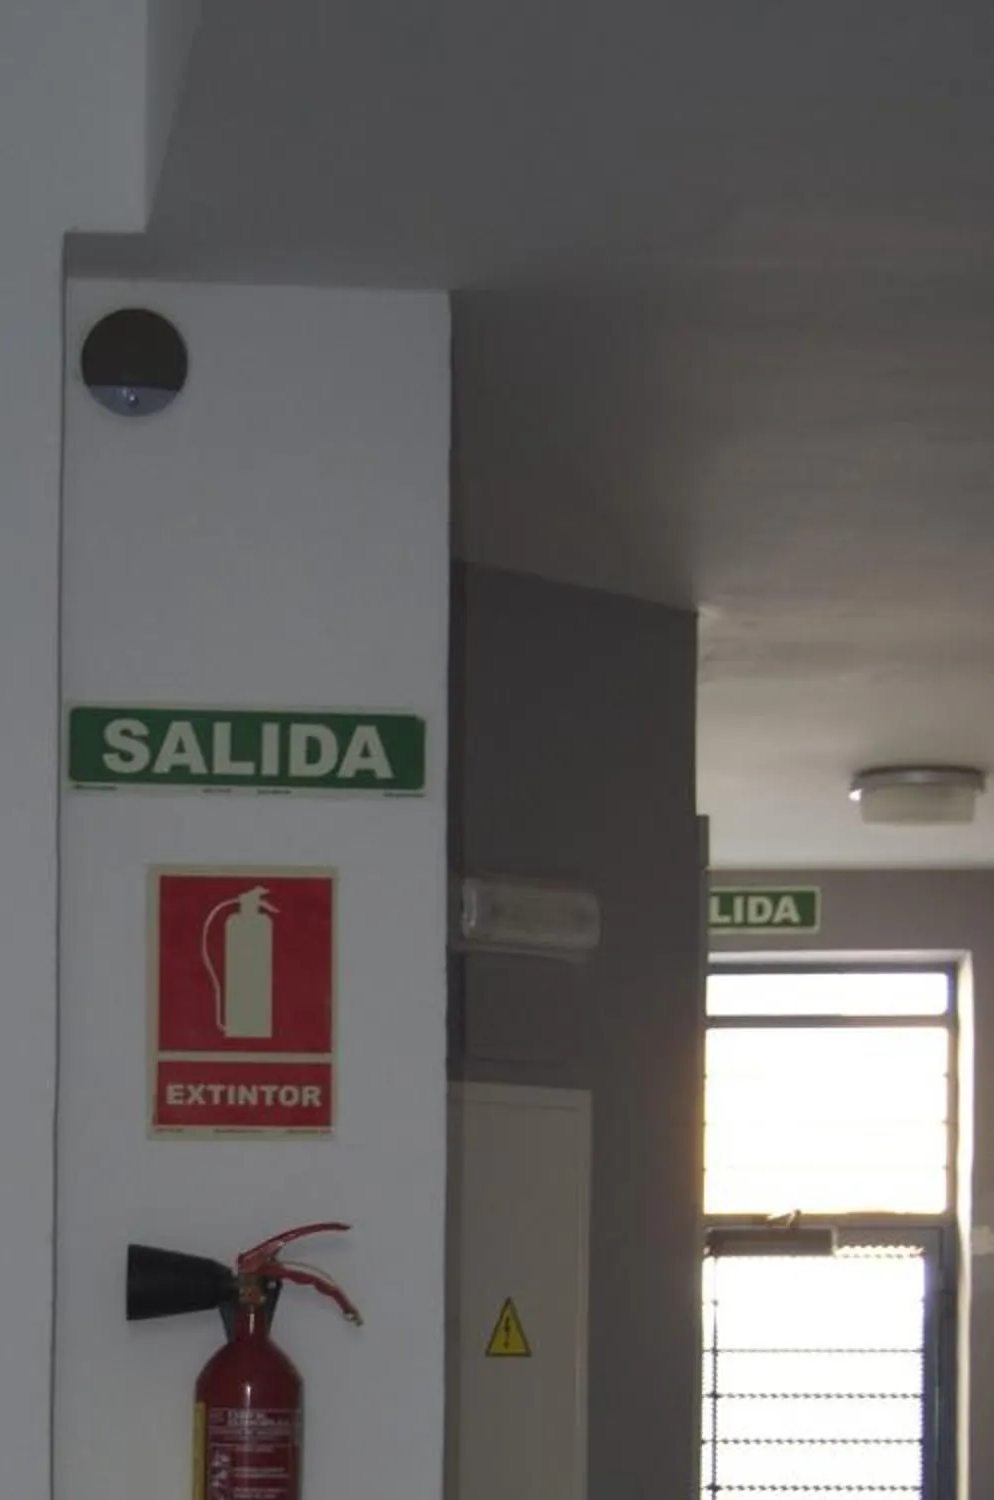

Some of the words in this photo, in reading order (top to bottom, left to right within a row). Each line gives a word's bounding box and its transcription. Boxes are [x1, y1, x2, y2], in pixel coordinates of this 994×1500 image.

[102, 718, 396, 780] SALIDA
[708, 895, 802, 924] LIDA
[165, 1083, 323, 1108] EXTINTOR
